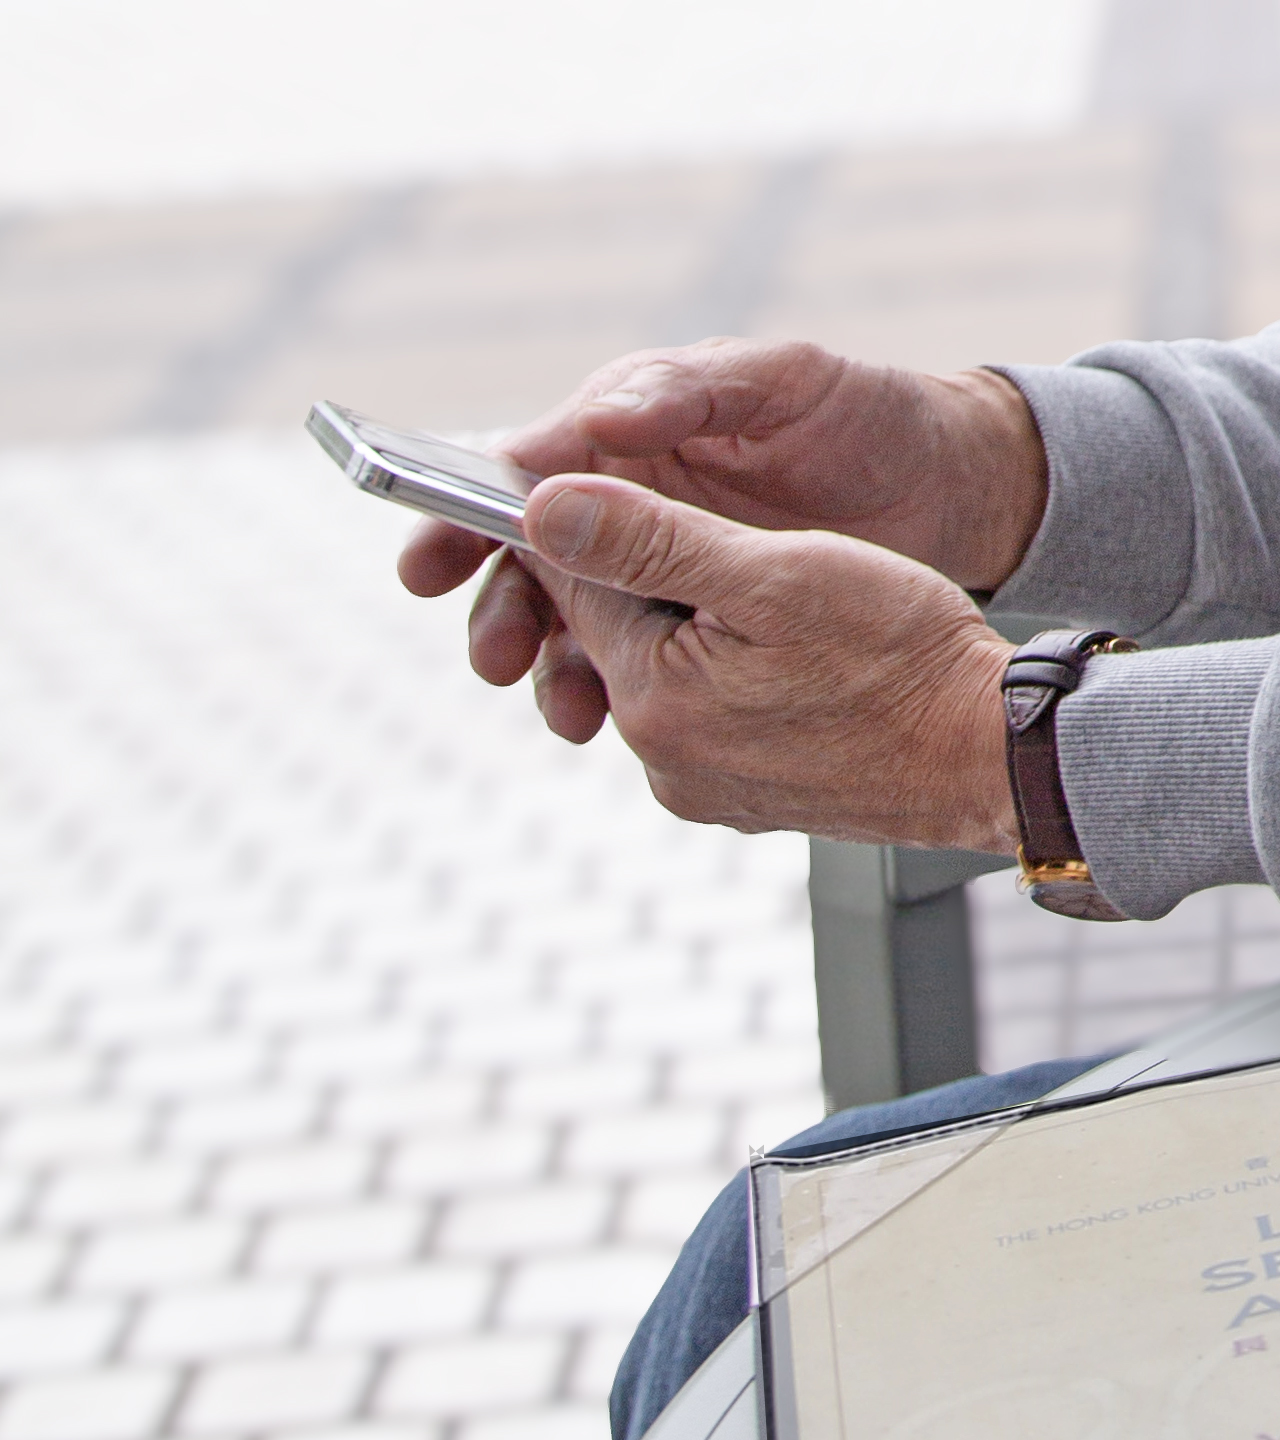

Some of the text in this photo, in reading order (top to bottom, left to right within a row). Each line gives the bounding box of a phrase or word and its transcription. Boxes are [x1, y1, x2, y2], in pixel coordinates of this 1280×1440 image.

[994, 1229, 1041, 1249] THE
[1045, 1207, 1131, 1238] HONG
[1135, 1187, 1218, 1217] KONG
